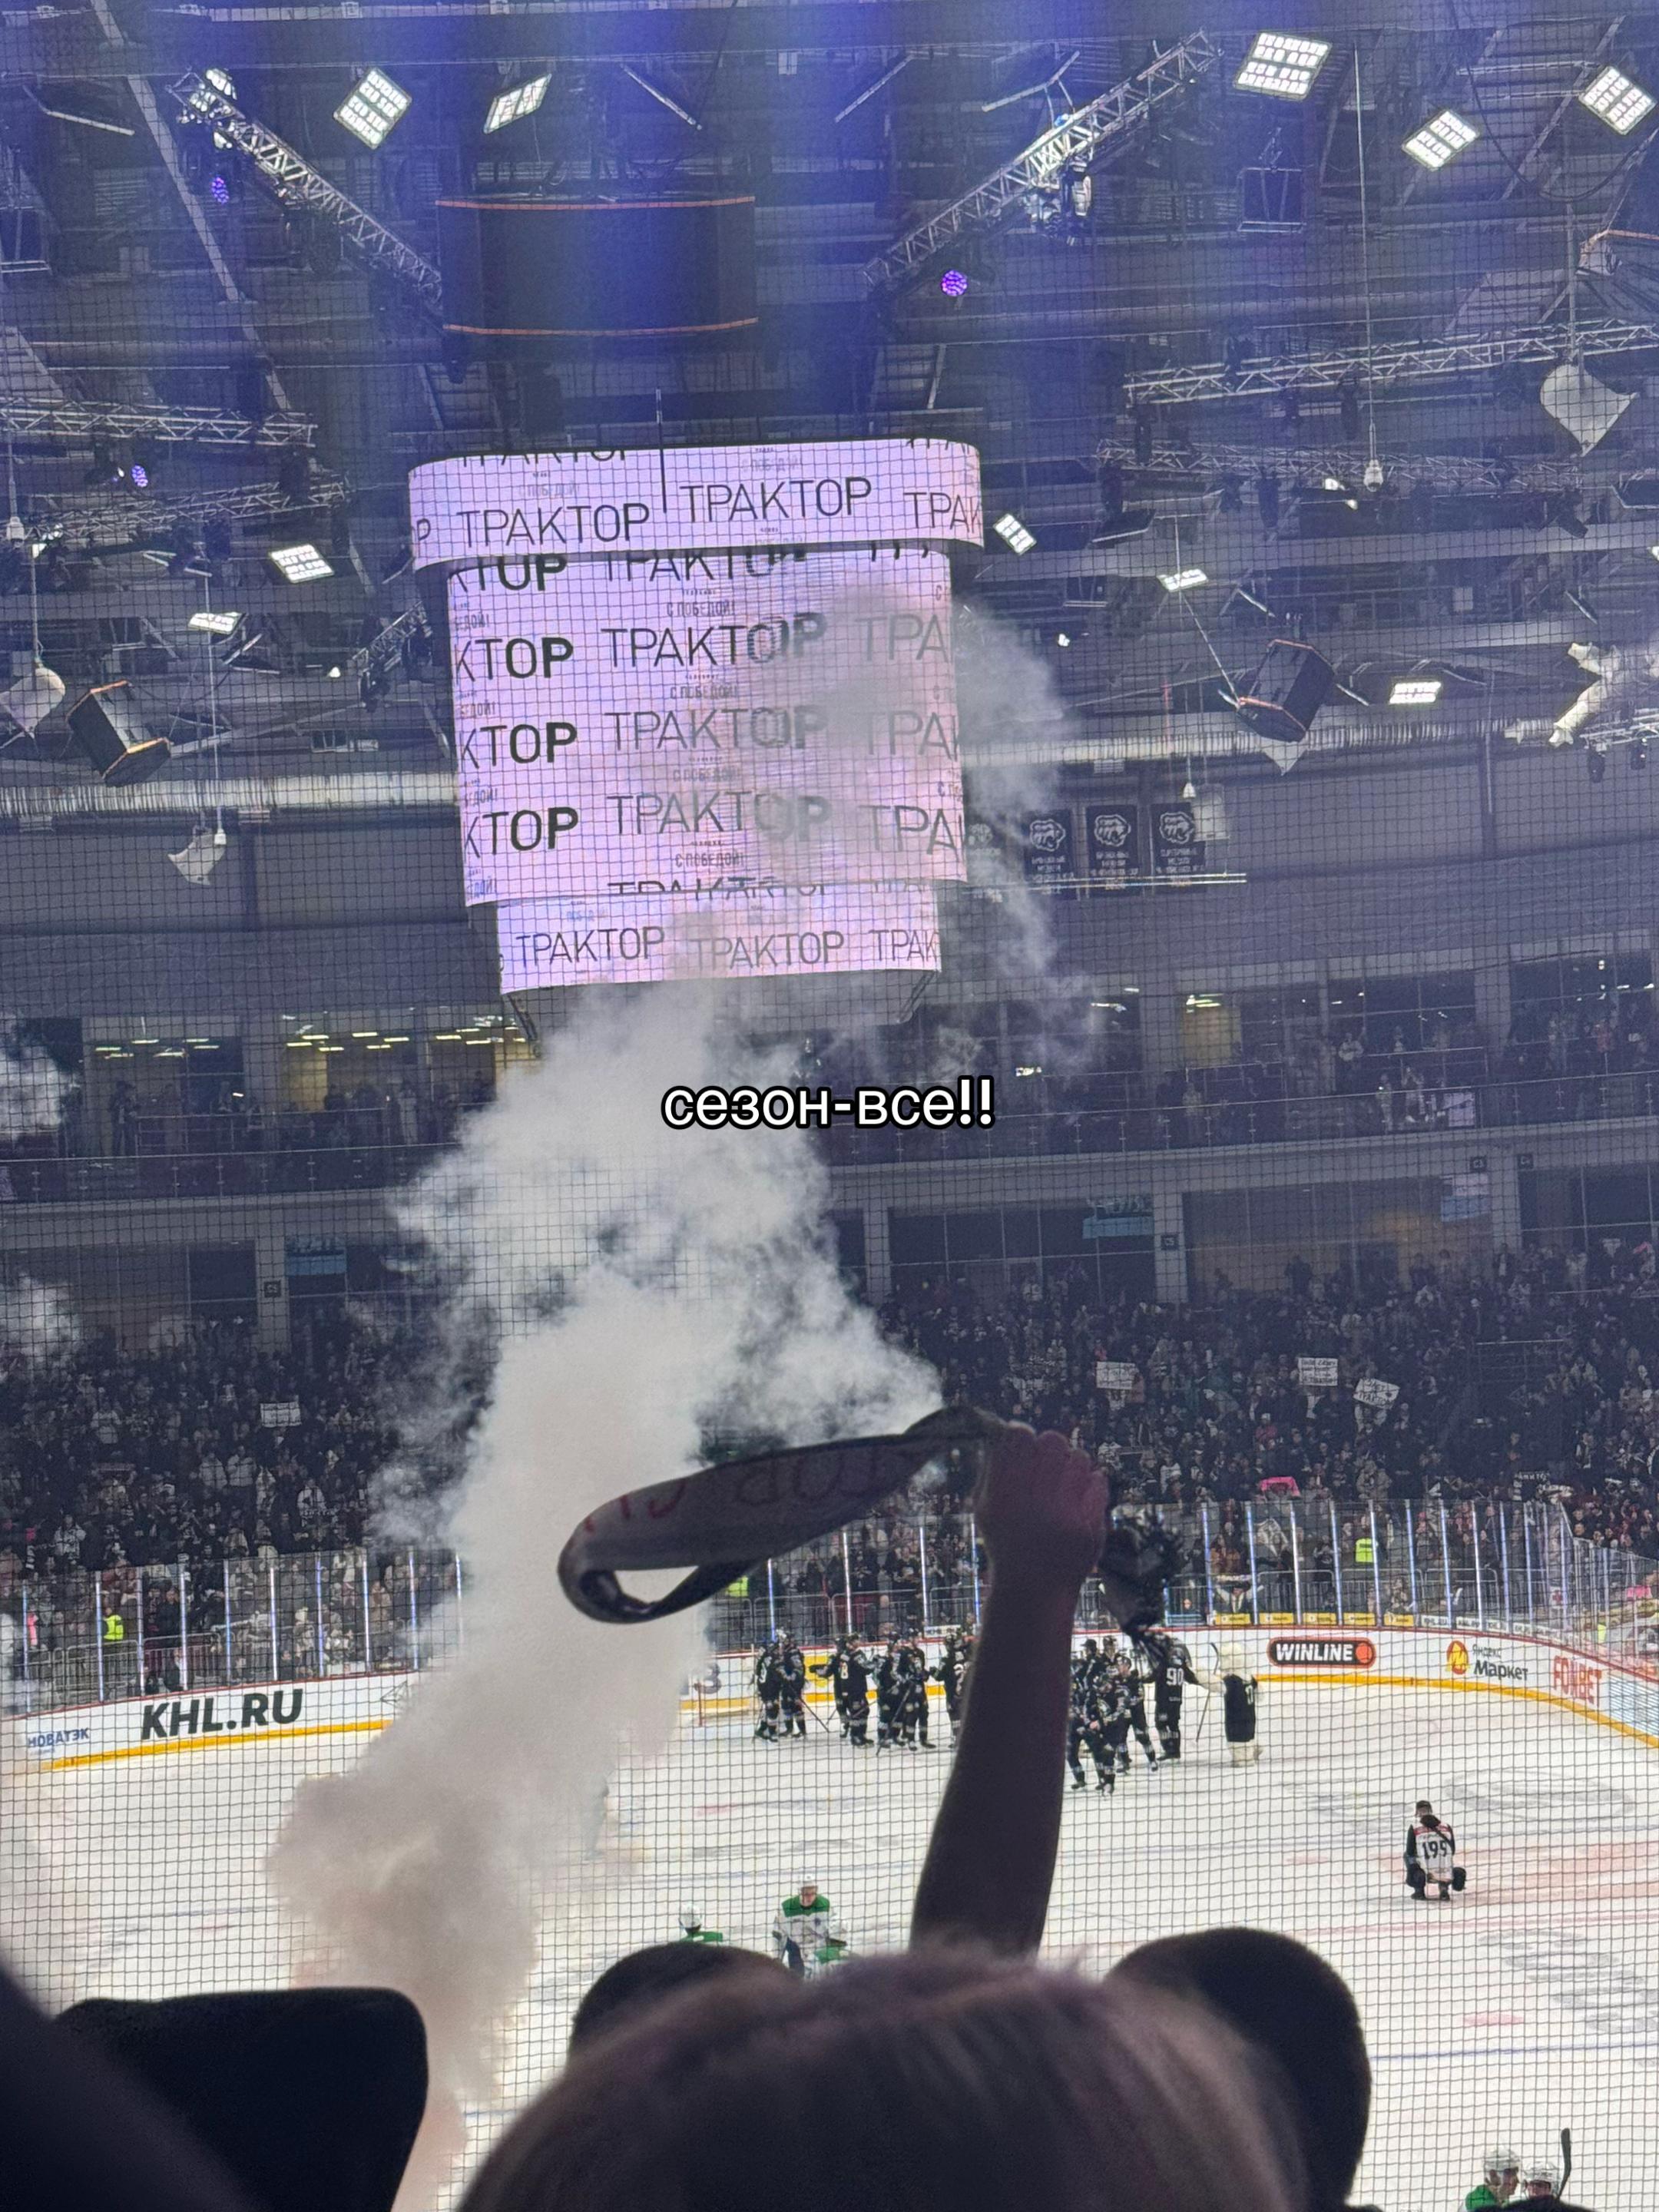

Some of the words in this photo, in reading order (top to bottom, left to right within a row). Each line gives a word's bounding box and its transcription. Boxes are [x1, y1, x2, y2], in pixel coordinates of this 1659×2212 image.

[679, 476, 872, 523] ТРАКТОР
[456, 502, 650, 548] ТРАКТОР
[601, 612, 828, 667] ТРАКТОР
[604, 705, 829, 750] ТРАКТОР
[607, 790, 833, 842] ТРАКТОР
[515, 926, 665, 968] ТРАКТОР
[689, 930, 845, 970] ТРАКТОР
[1276, 1643, 1353, 1662] WINLINE
[1474, 1659, 1528, 1681] Маркет
[1166, 1667, 1184, 1686] 90
[141, 1687, 303, 1741] KHL.RU
[28, 1727, 90, 1748] НОВАТЭК
